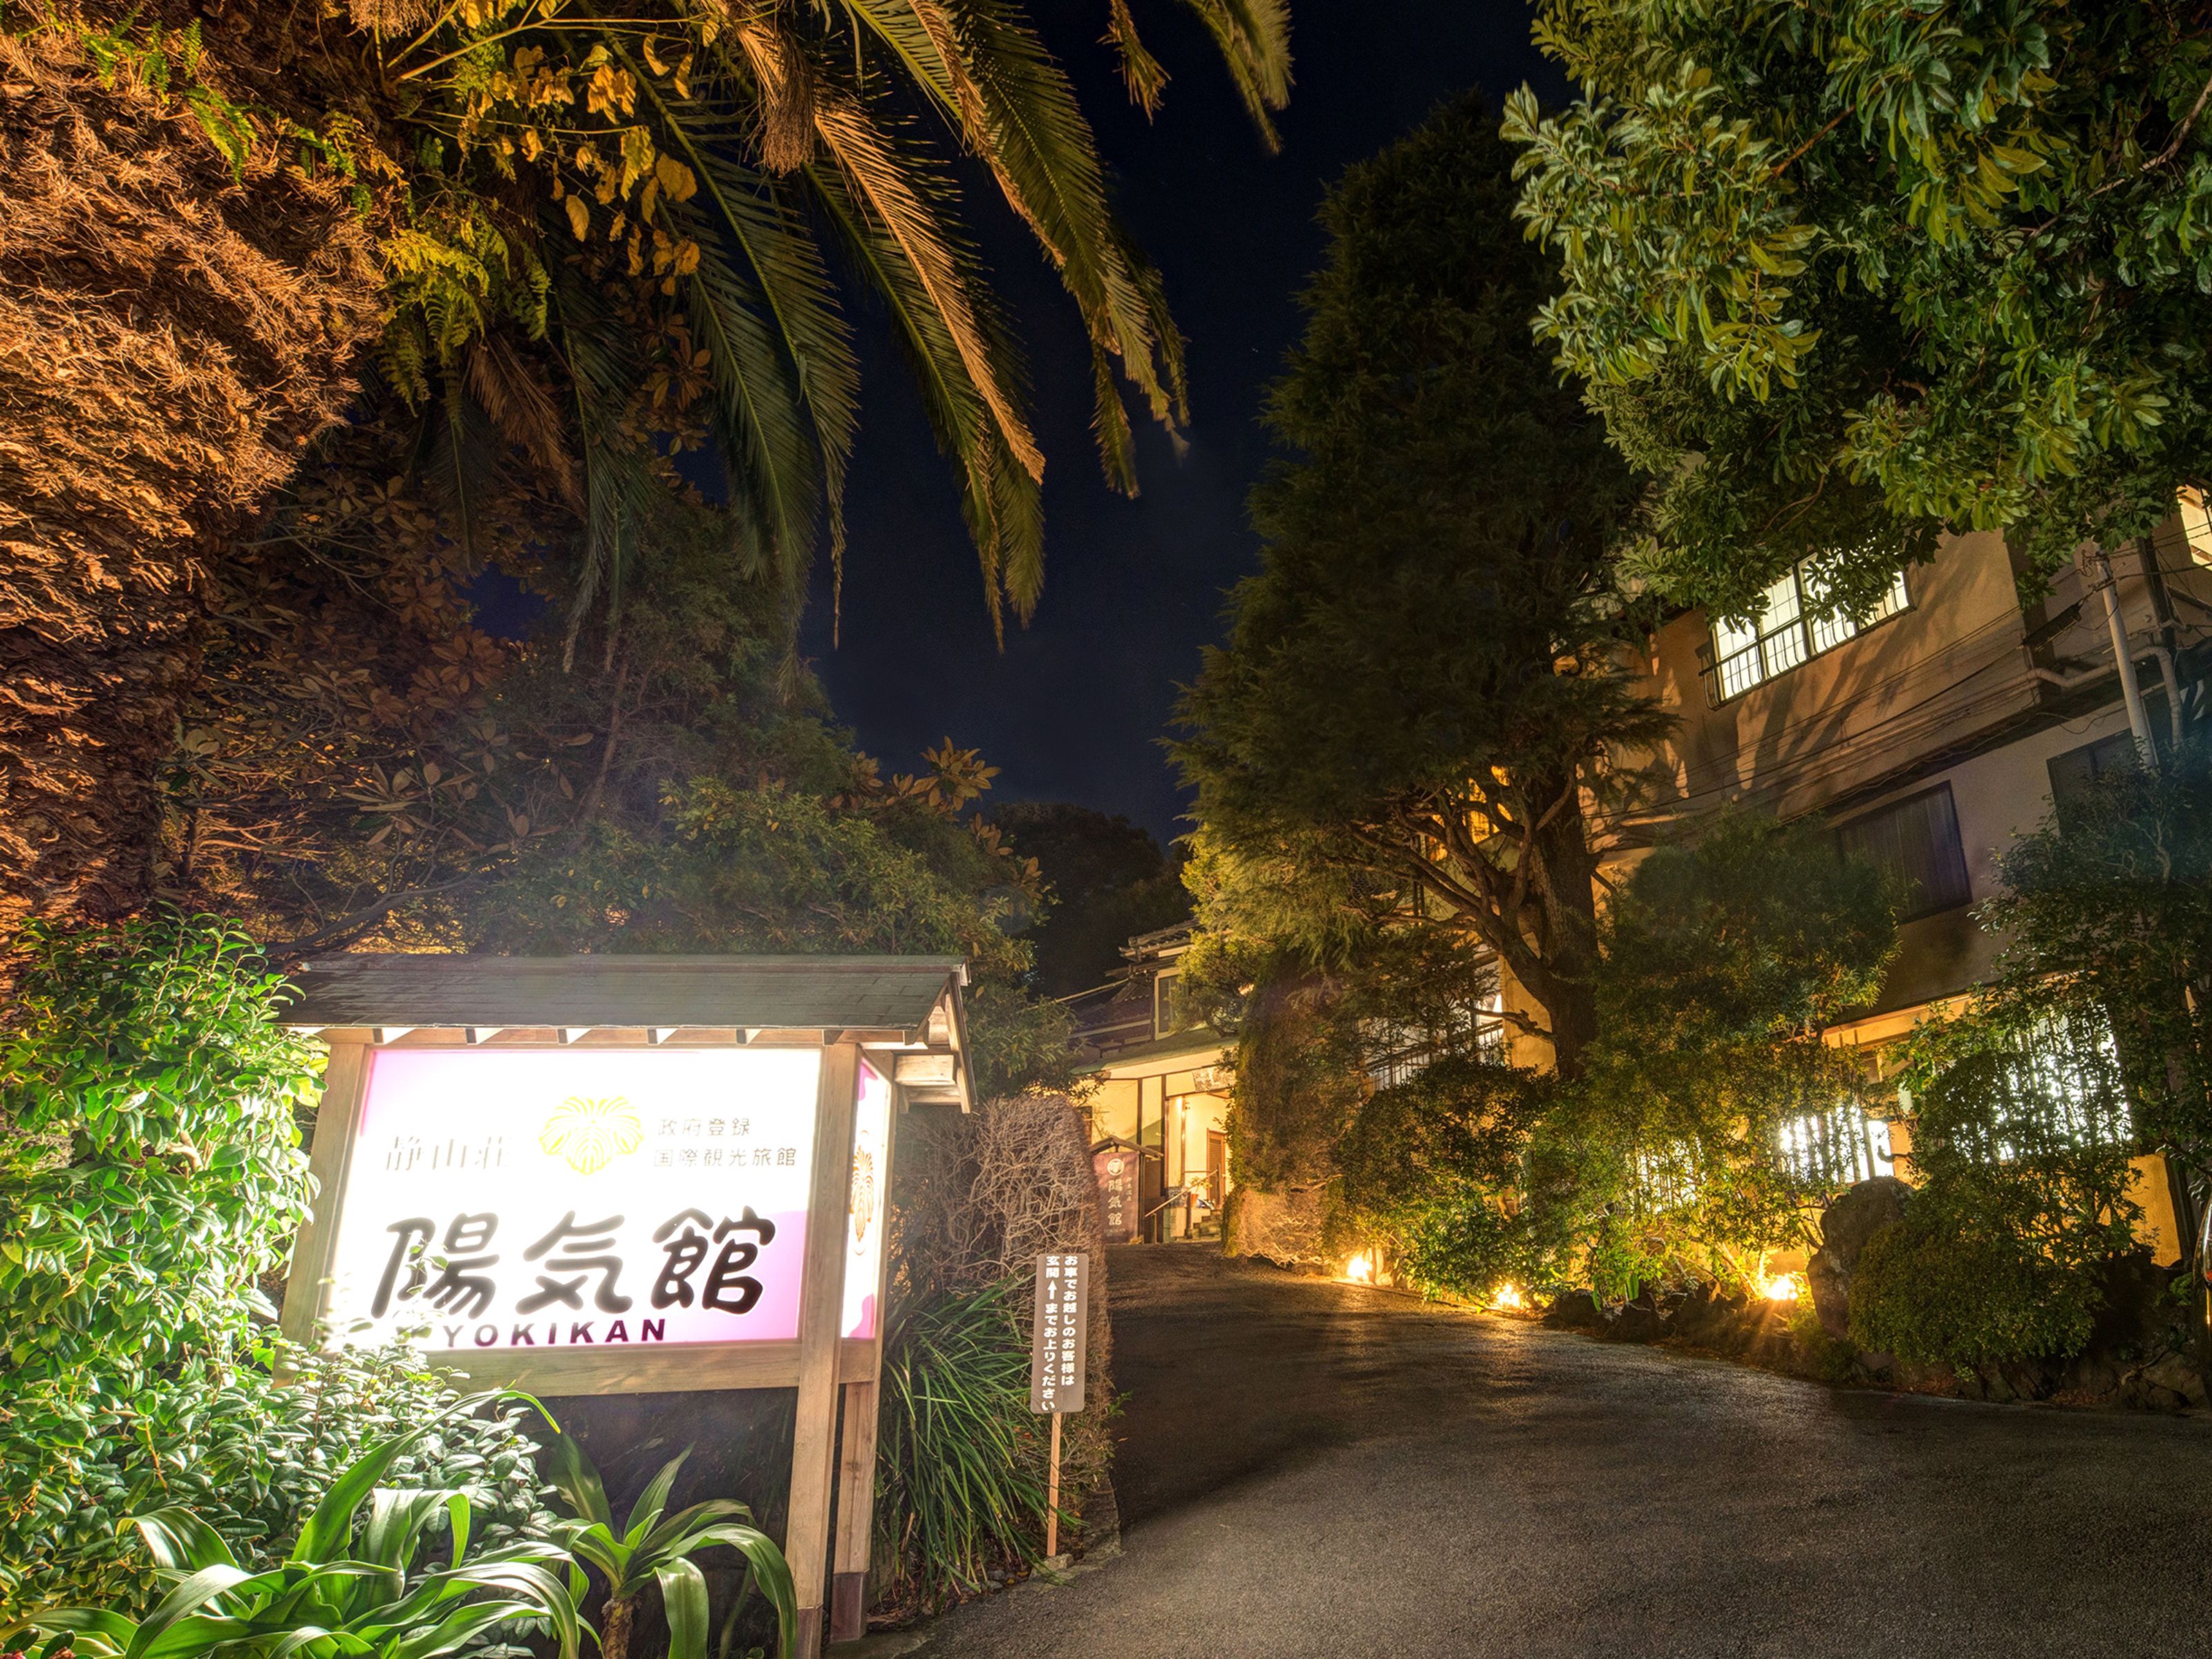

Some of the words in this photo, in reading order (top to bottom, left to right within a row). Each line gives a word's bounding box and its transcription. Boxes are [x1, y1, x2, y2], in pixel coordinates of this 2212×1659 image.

[658, 1118, 751, 1137] 政府登録
[654, 1147, 797, 1168] 国際観光旅館
[1108, 1179, 1123, 1226] 陽気館
[372, 1207, 776, 1318] 陽気館
[1045, 1255, 1060, 1278] 玄関
[442, 1319, 666, 1347] YOKIKAN
[1061, 1255, 1078, 1385] お車でお越しのお客様は
[1041, 1303, 1058, 1411] までお上りください
